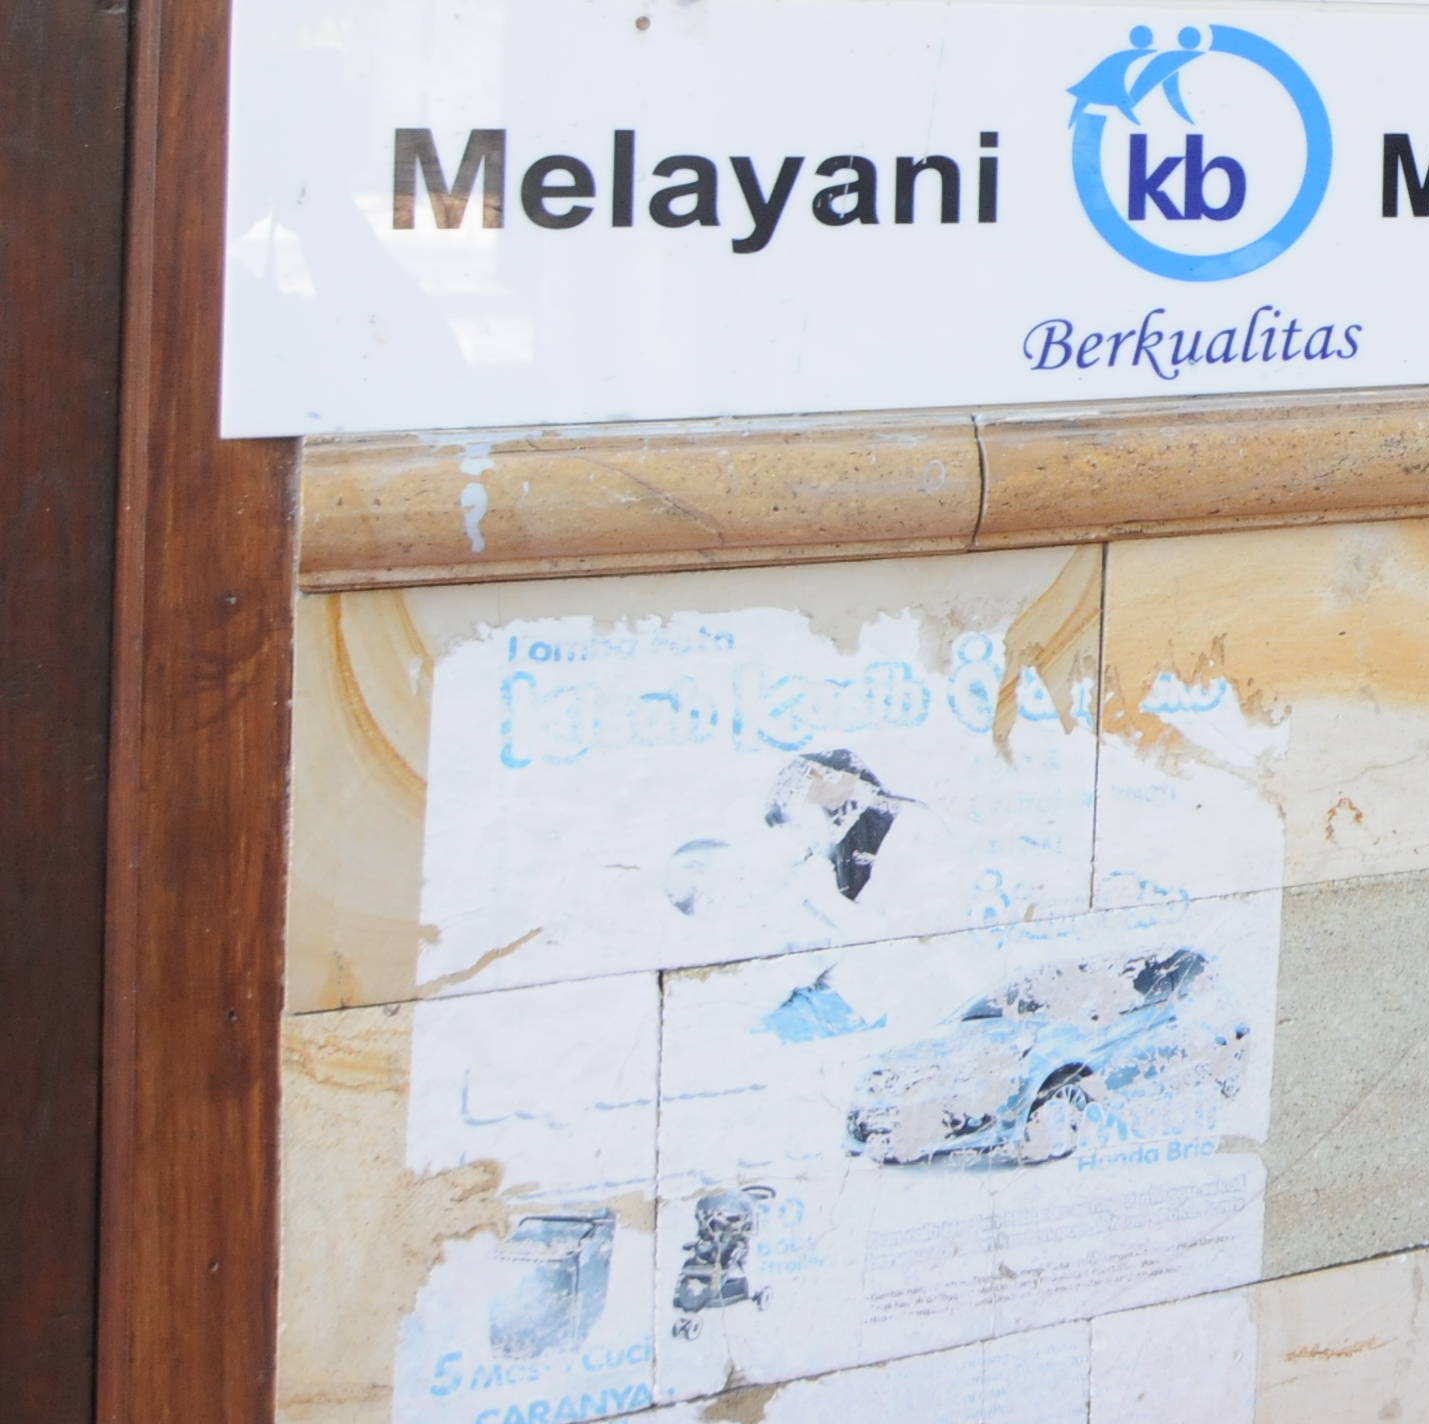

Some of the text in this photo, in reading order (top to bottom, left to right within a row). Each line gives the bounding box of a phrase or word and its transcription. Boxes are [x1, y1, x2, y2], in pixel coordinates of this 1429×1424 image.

[392, 128, 999, 254] Melayani
[1126, 135, 1246, 221] kb
[1022, 304, 1361, 380] Berkualitas
[1167, 1140, 1216, 1161] Brio
